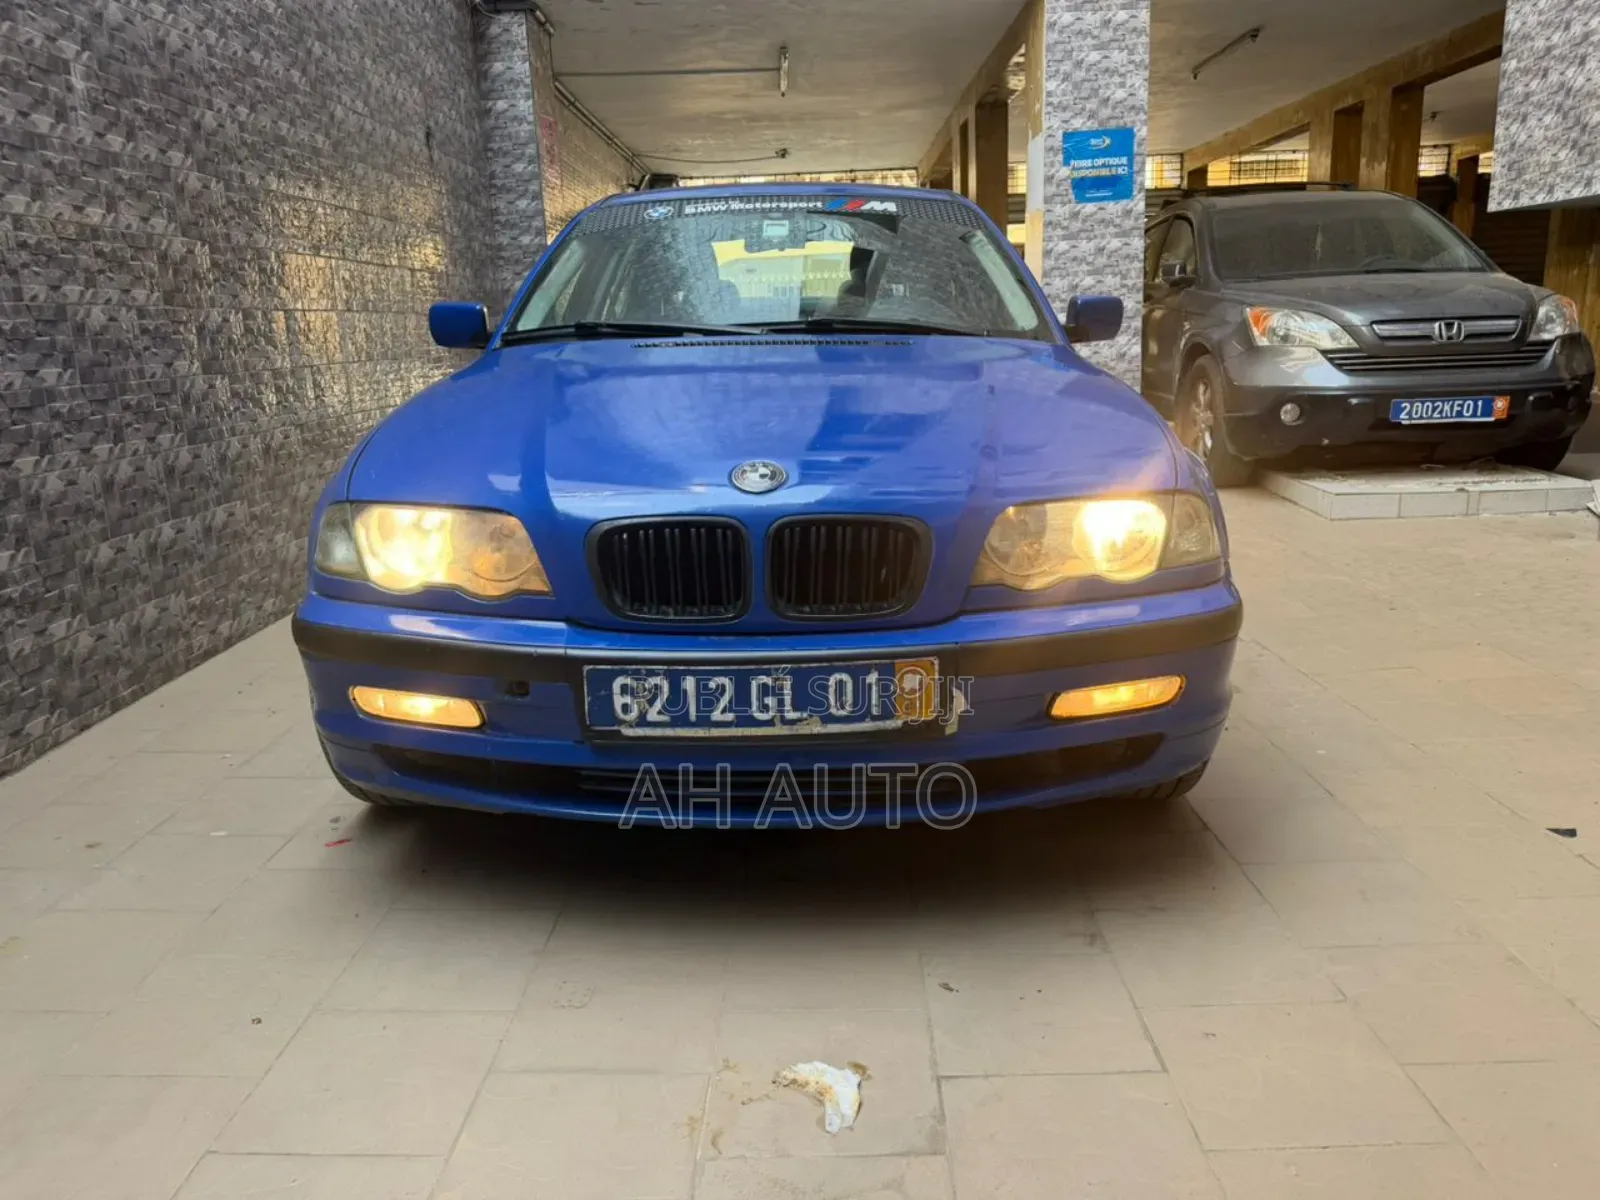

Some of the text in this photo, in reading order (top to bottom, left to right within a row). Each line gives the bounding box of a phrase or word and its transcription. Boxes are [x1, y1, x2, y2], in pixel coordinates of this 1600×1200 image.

[1093, 156, 1128, 167] OPTIQUE
[684, 203, 728, 215] BMW
[730, 201, 823, 210] Motorsport
[1399, 400, 1483, 419] 2002KF01
[612, 670, 880, 722] 6212 GL 01
